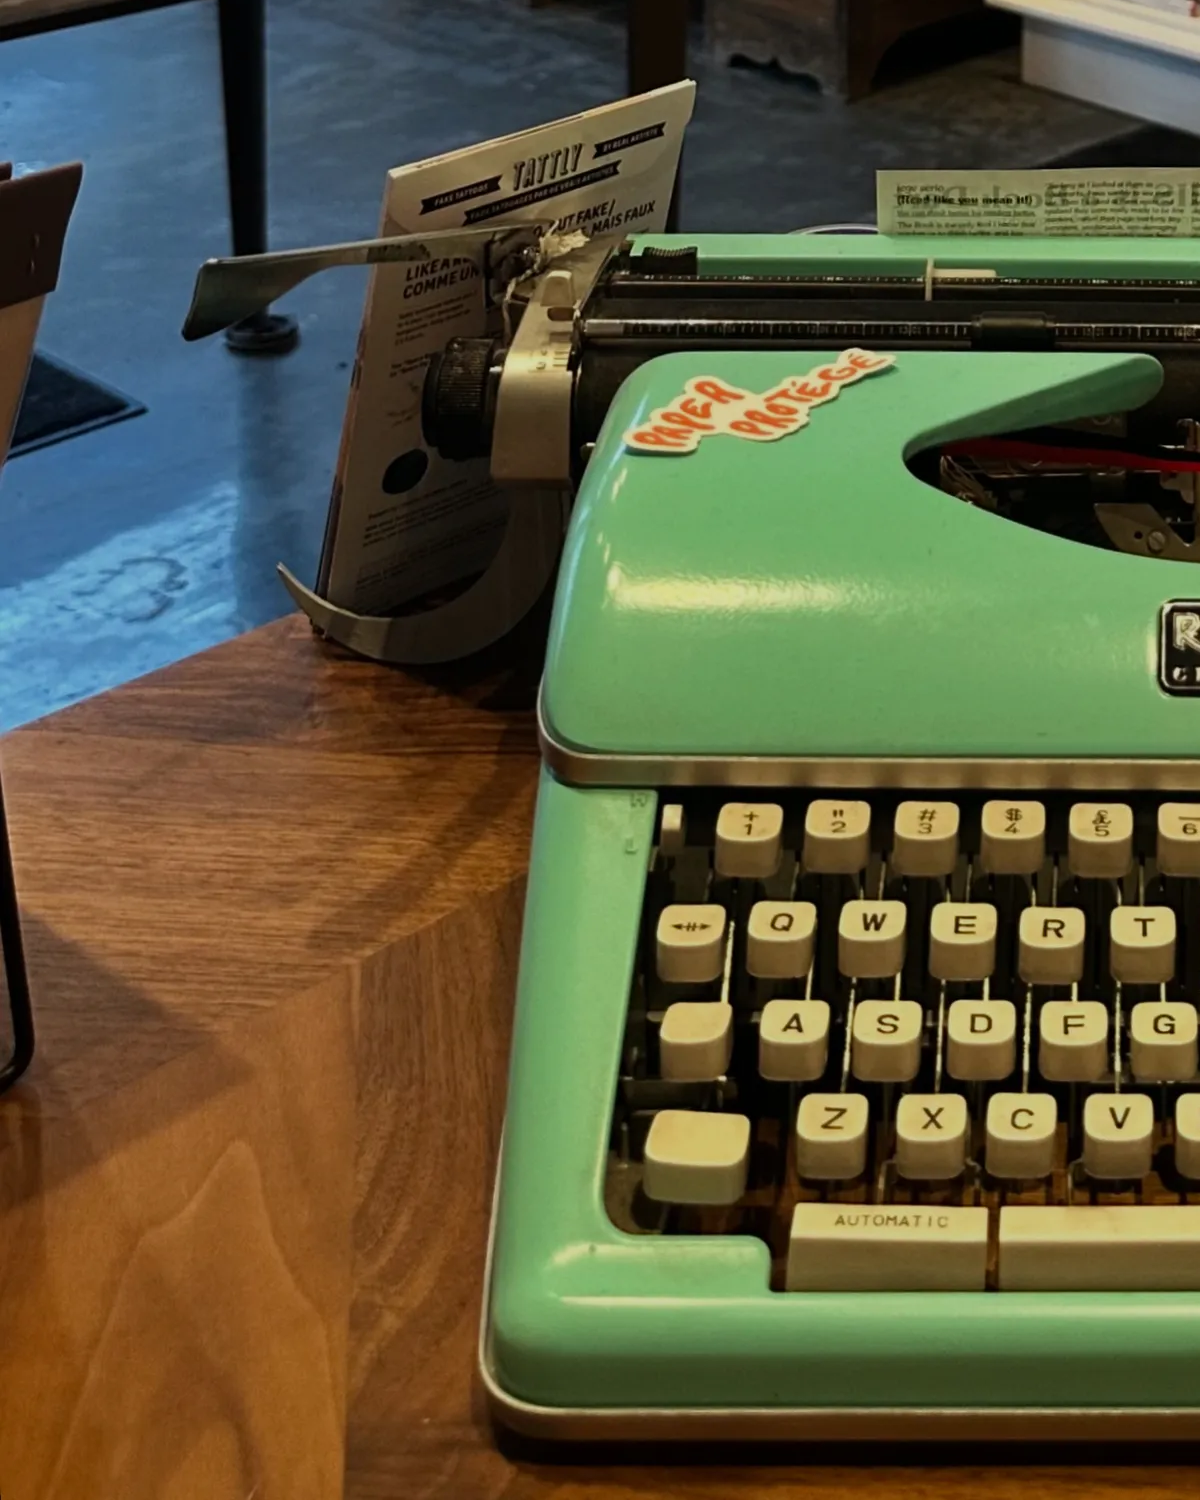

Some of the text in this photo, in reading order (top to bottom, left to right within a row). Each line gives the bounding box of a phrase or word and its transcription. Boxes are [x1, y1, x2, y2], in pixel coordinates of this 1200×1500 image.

[512, 142, 584, 192] TATTLY
[624, 201, 656, 226] FAUX
[632, 380, 746, 448] PAPER
[919, 809, 936, 822] #
[1006, 807, 1022, 822] $
[831, 821, 847, 834] 2
[918, 822, 933, 835] 3
[1004, 822, 1018, 834] 4
[1094, 825, 1110, 837] 5
[1182, 823, 1198, 835] 6
[770, 912, 794, 932] Q
[862, 912, 887, 932] W
[953, 915, 977, 935] E
[1042, 918, 1066, 939] R
[1133, 917, 1155, 938] T
[782, 1012, 804, 1034] A
[876, 1014, 900, 1034] S
[969, 1013, 993, 1034] D
[1063, 1015, 1085, 1036] F
[1152, 1013, 1176, 1035] G
[820, 1106, 848, 1130] Z
[922, 1107, 944, 1130] X
[1010, 1108, 1035, 1130] C
[1109, 1107, 1131, 1130] V
[834, 1214, 950, 1228] AUTOMATIC
